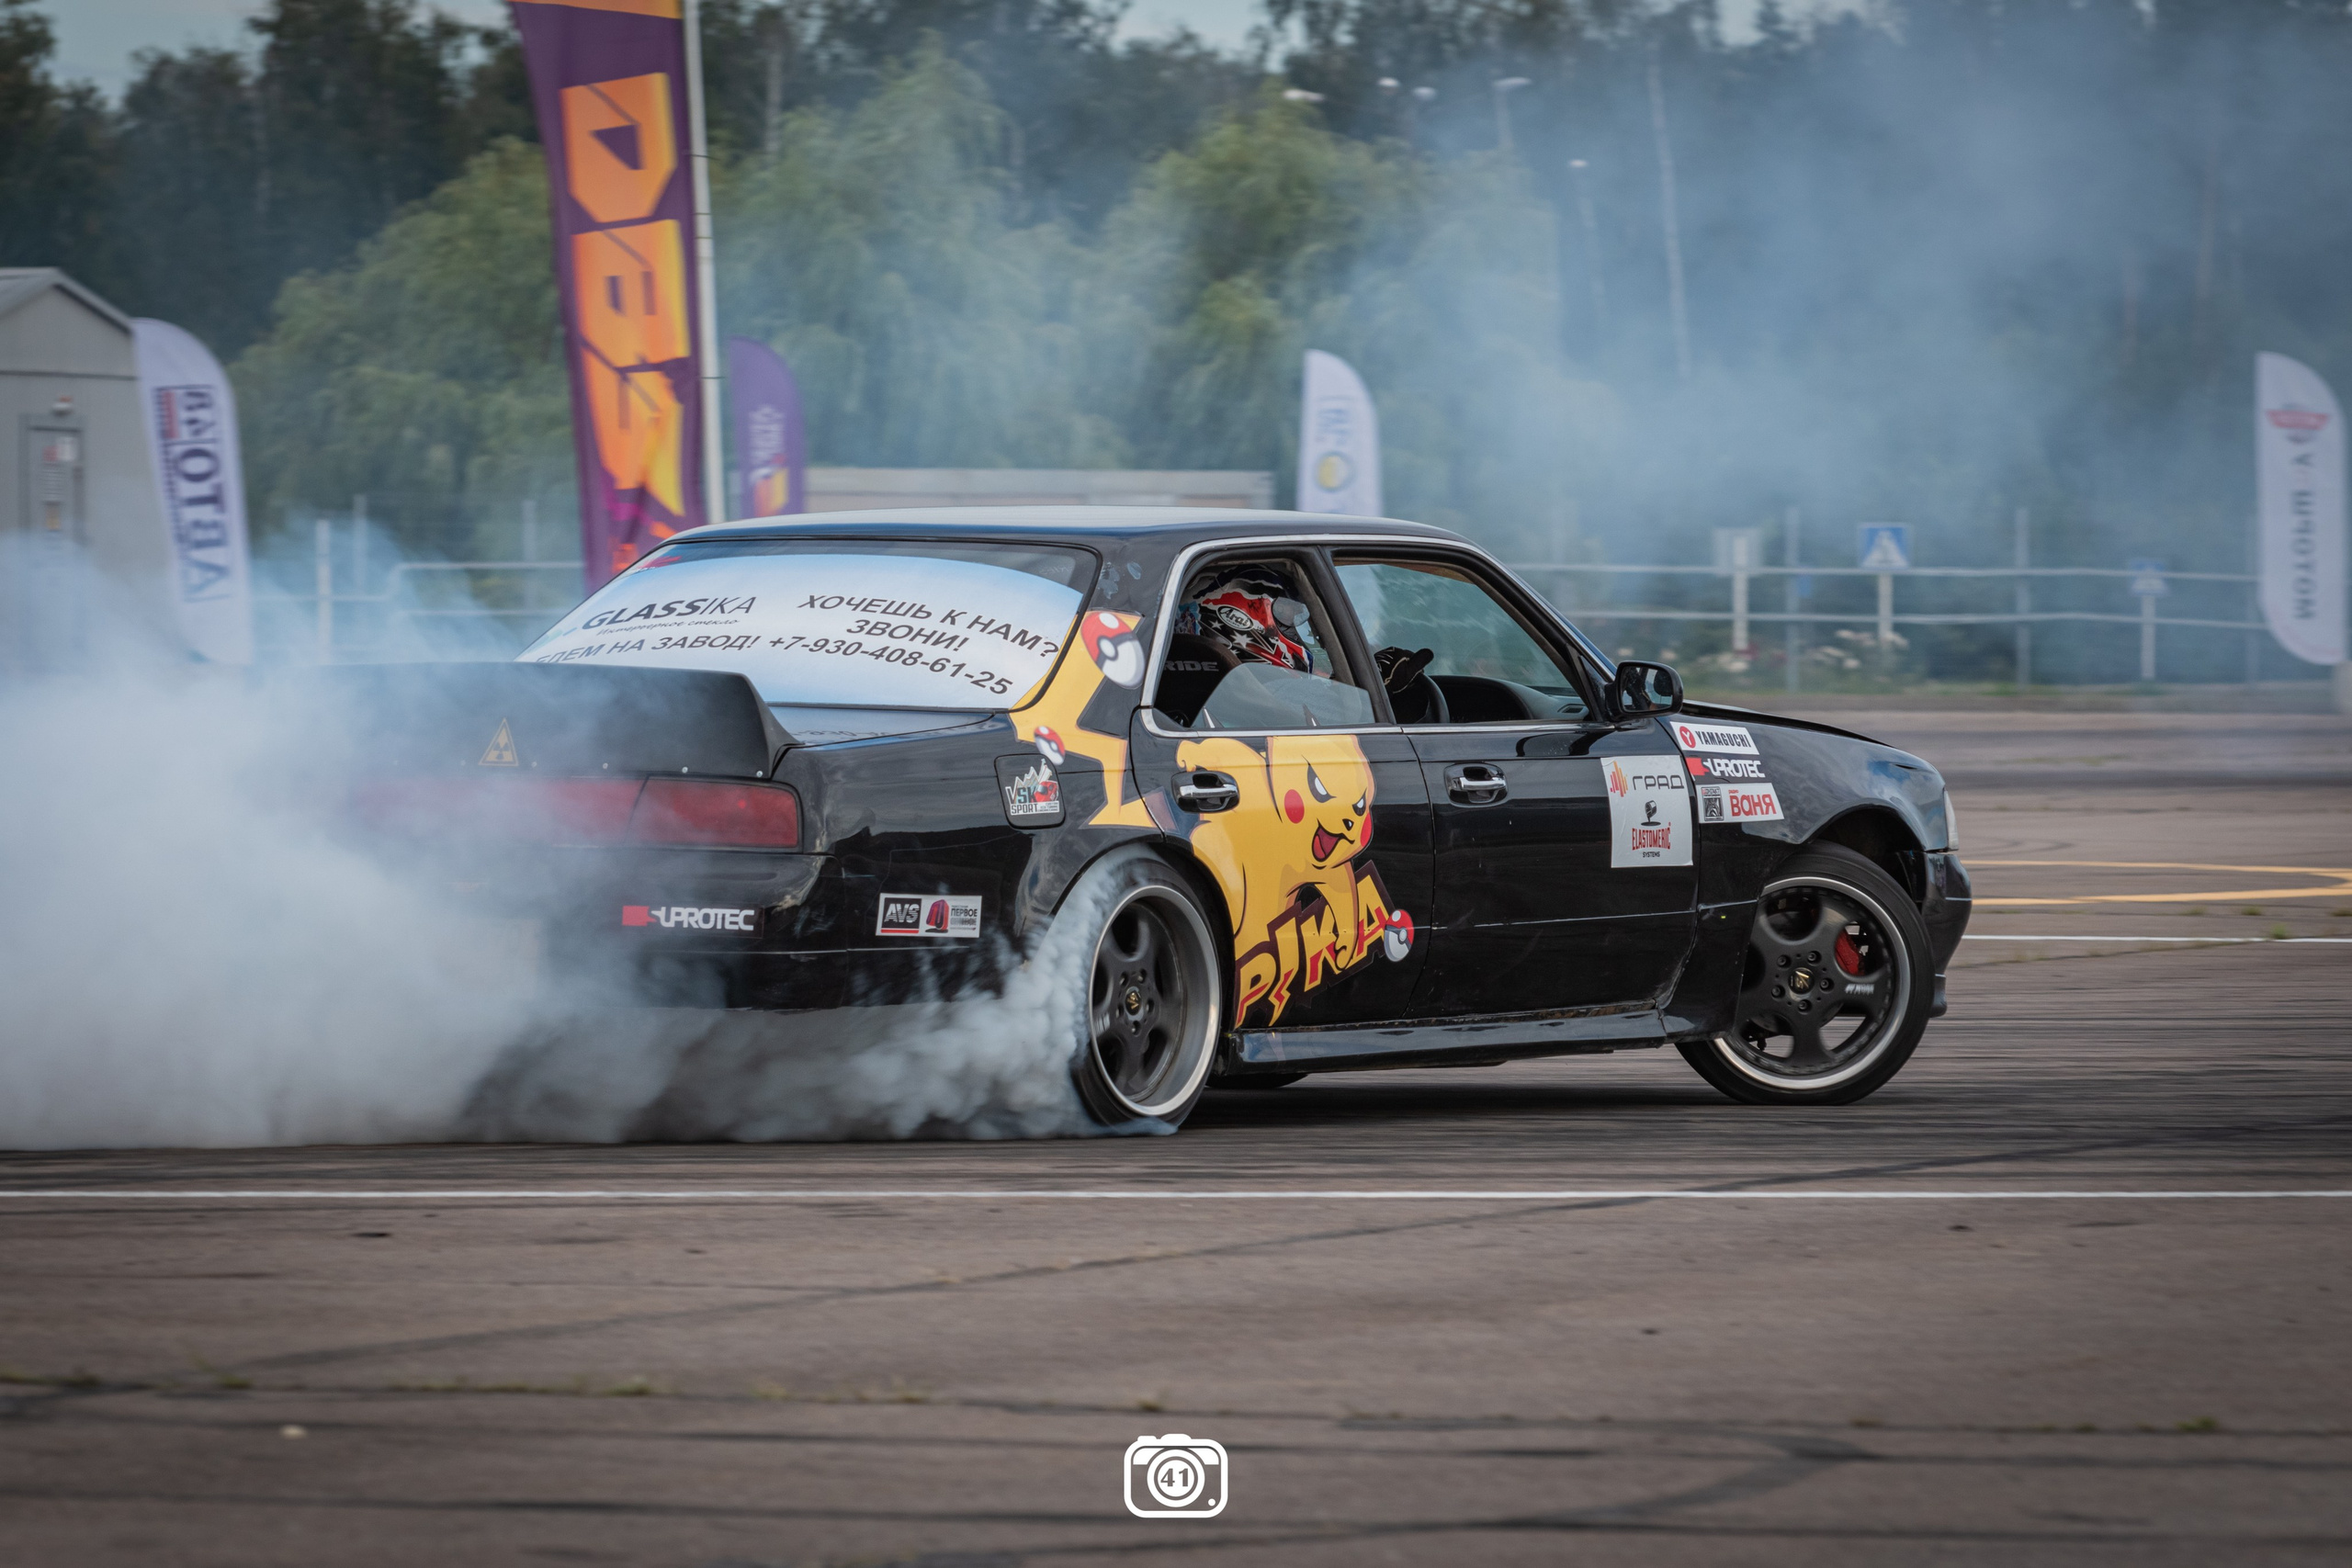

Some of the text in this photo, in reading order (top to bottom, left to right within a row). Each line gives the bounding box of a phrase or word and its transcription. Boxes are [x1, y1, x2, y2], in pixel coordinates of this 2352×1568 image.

[582, 596, 756, 630] GLASSIKA
[1219, 607, 1250, 626] Arai
[797, 595, 1059, 658] ХОЧЕШЬ К НАМ?
[846, 619, 970, 652] ЗВОНИ!
[606, 638, 645, 655] НА
[651, 635, 762, 651] ЗАВОД!
[769, 636, 1013, 695] +7-930-408-61-25
[1695, 731, 1752, 748] YAMAGUCHI
[1633, 774, 1685, 790] ГРАД
[1012, 804, 1038, 814] SPORT
[884, 903, 920, 923] AVS
[950, 908, 978, 917] ПЕРВОЕ
[1235, 874, 1389, 1030] PIKA
